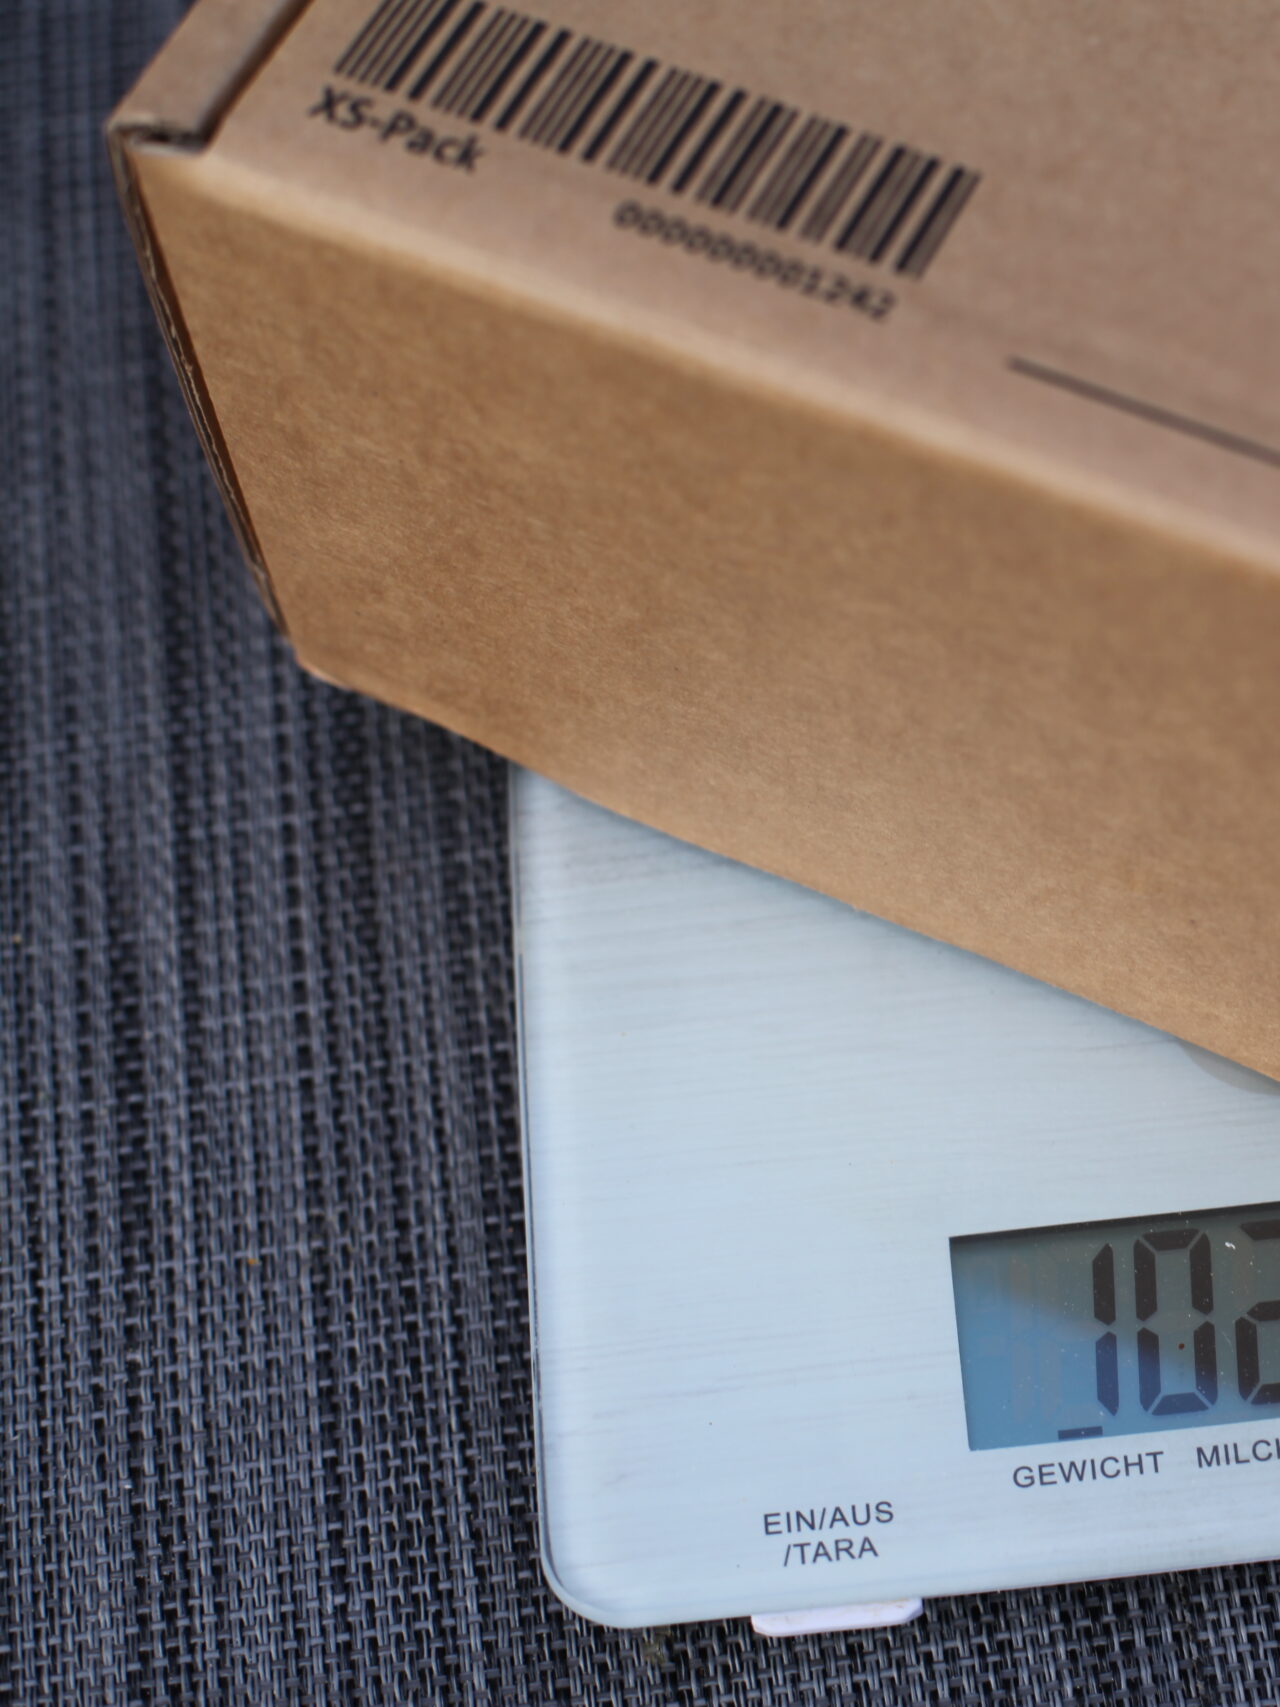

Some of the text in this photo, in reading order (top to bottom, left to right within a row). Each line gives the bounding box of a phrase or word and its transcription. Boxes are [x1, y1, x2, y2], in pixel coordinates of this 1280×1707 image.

[308, 84, 489, 175] XS-Pack
[1012, 1450, 1165, 1488] GEWICHT
[763, 1501, 895, 1535] EIN/AUS
[783, 1536, 879, 1567] /TARA
